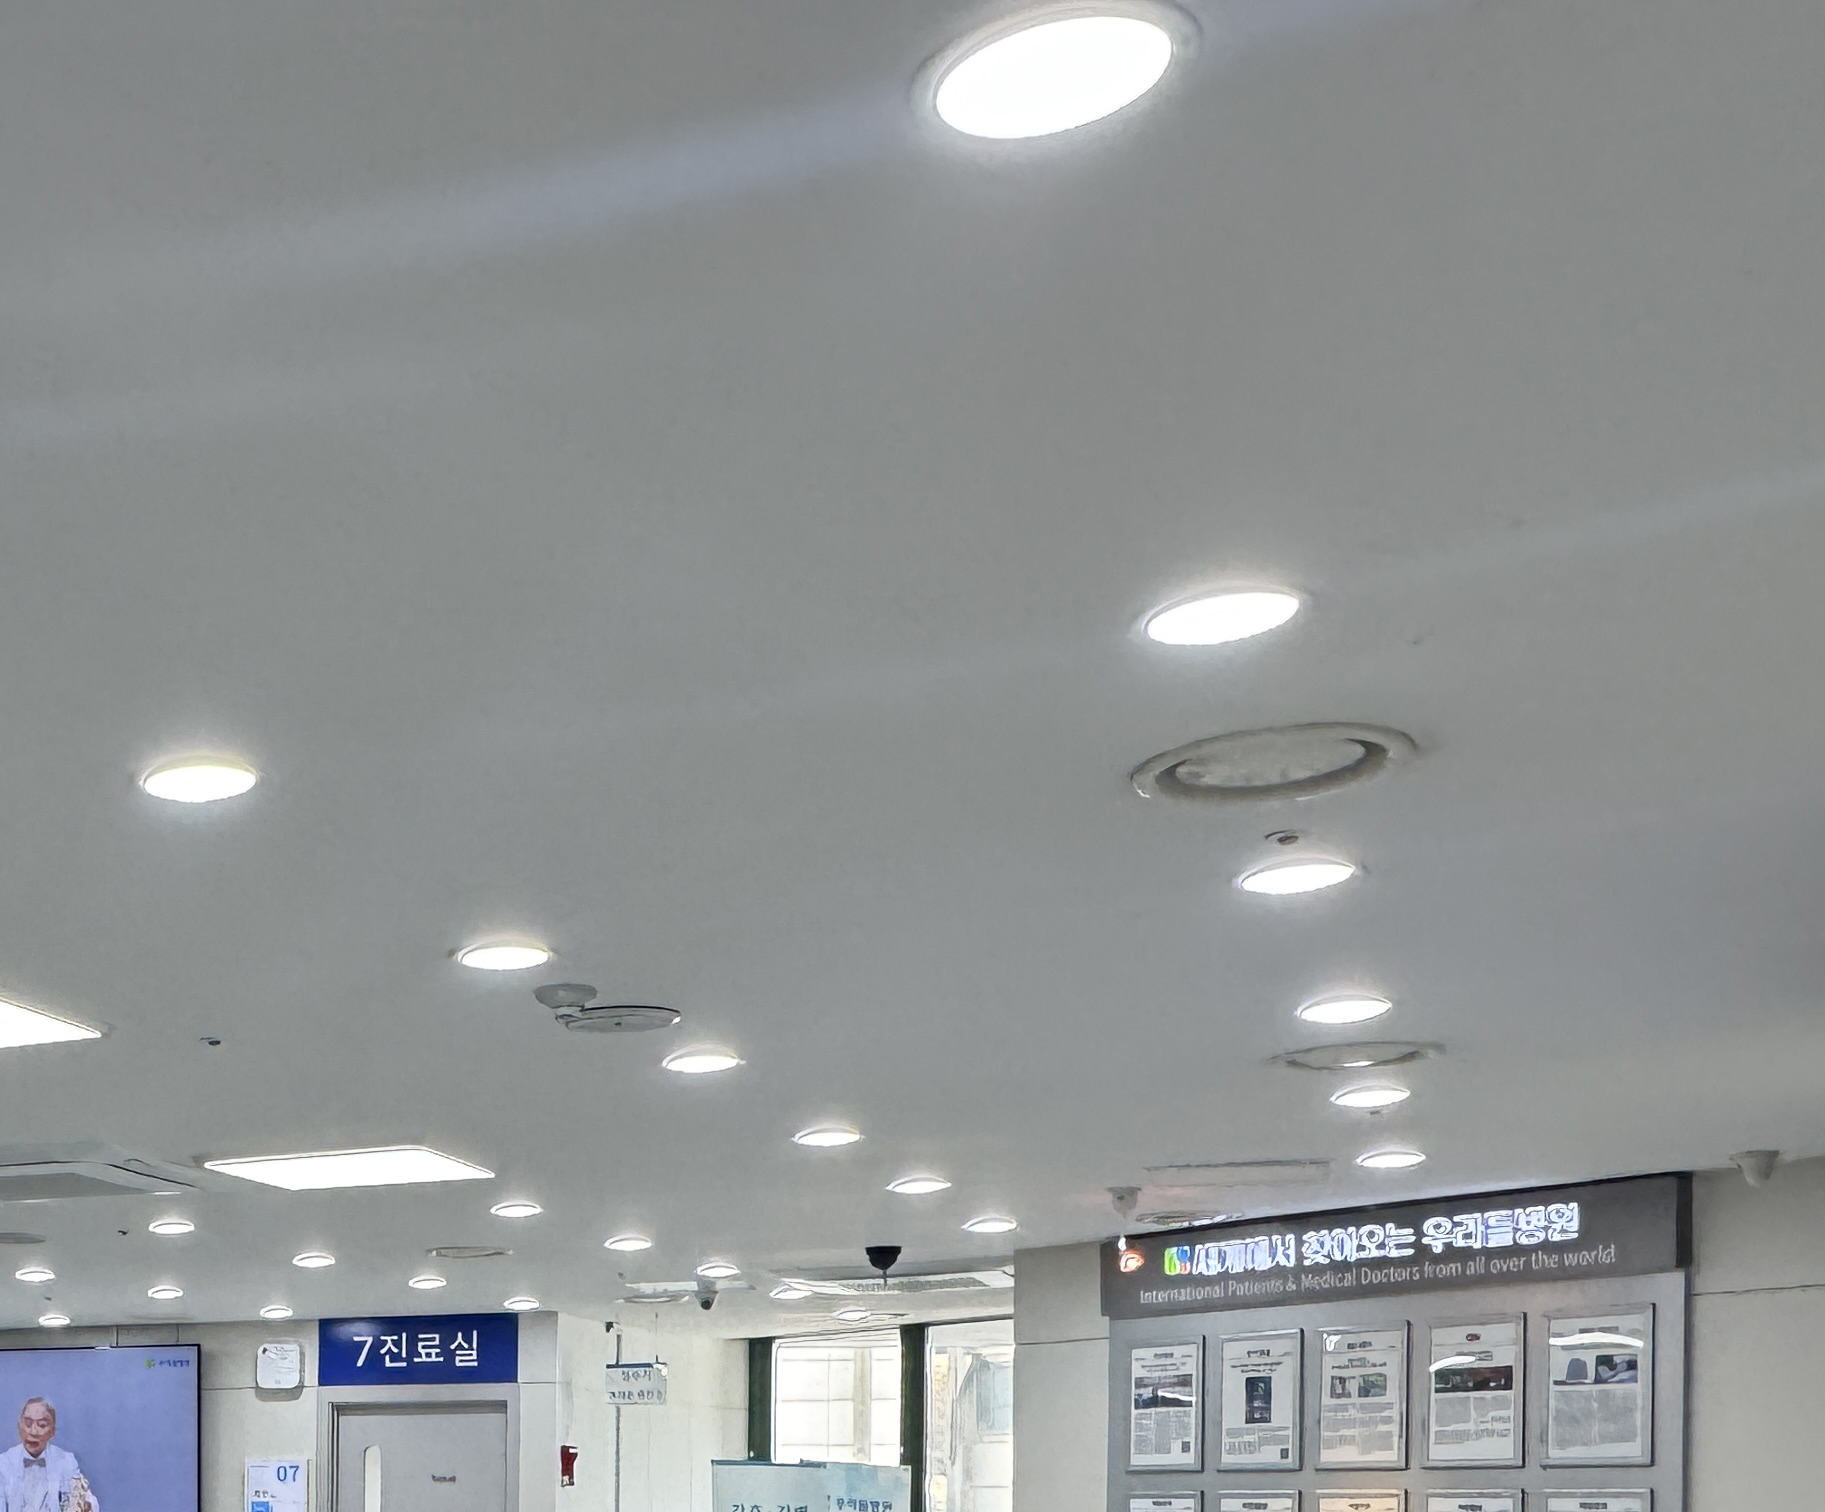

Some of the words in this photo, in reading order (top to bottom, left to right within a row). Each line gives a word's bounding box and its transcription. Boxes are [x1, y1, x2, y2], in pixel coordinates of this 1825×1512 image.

[1302, 1223, 1416, 1265] 찾아오는
[1422, 1202, 1578, 1253] 우리들병원
[1140, 1281, 1225, 1304] International
[1228, 1278, 1283, 1298] Patients
[1301, 1269, 1356, 1289] Medical
[1361, 1263, 1420, 1285] Doctors
[1425, 1260, 1462, 1278] from
[1466, 1257, 1485, 1275] all
[1490, 1256, 1526, 1274] over
[1531, 1250, 1559, 1269] the
[1563, 1244, 1616, 1266] world
[352, 1329, 478, 1368] 7진료실
[276, 1465, 300, 1482] 07
